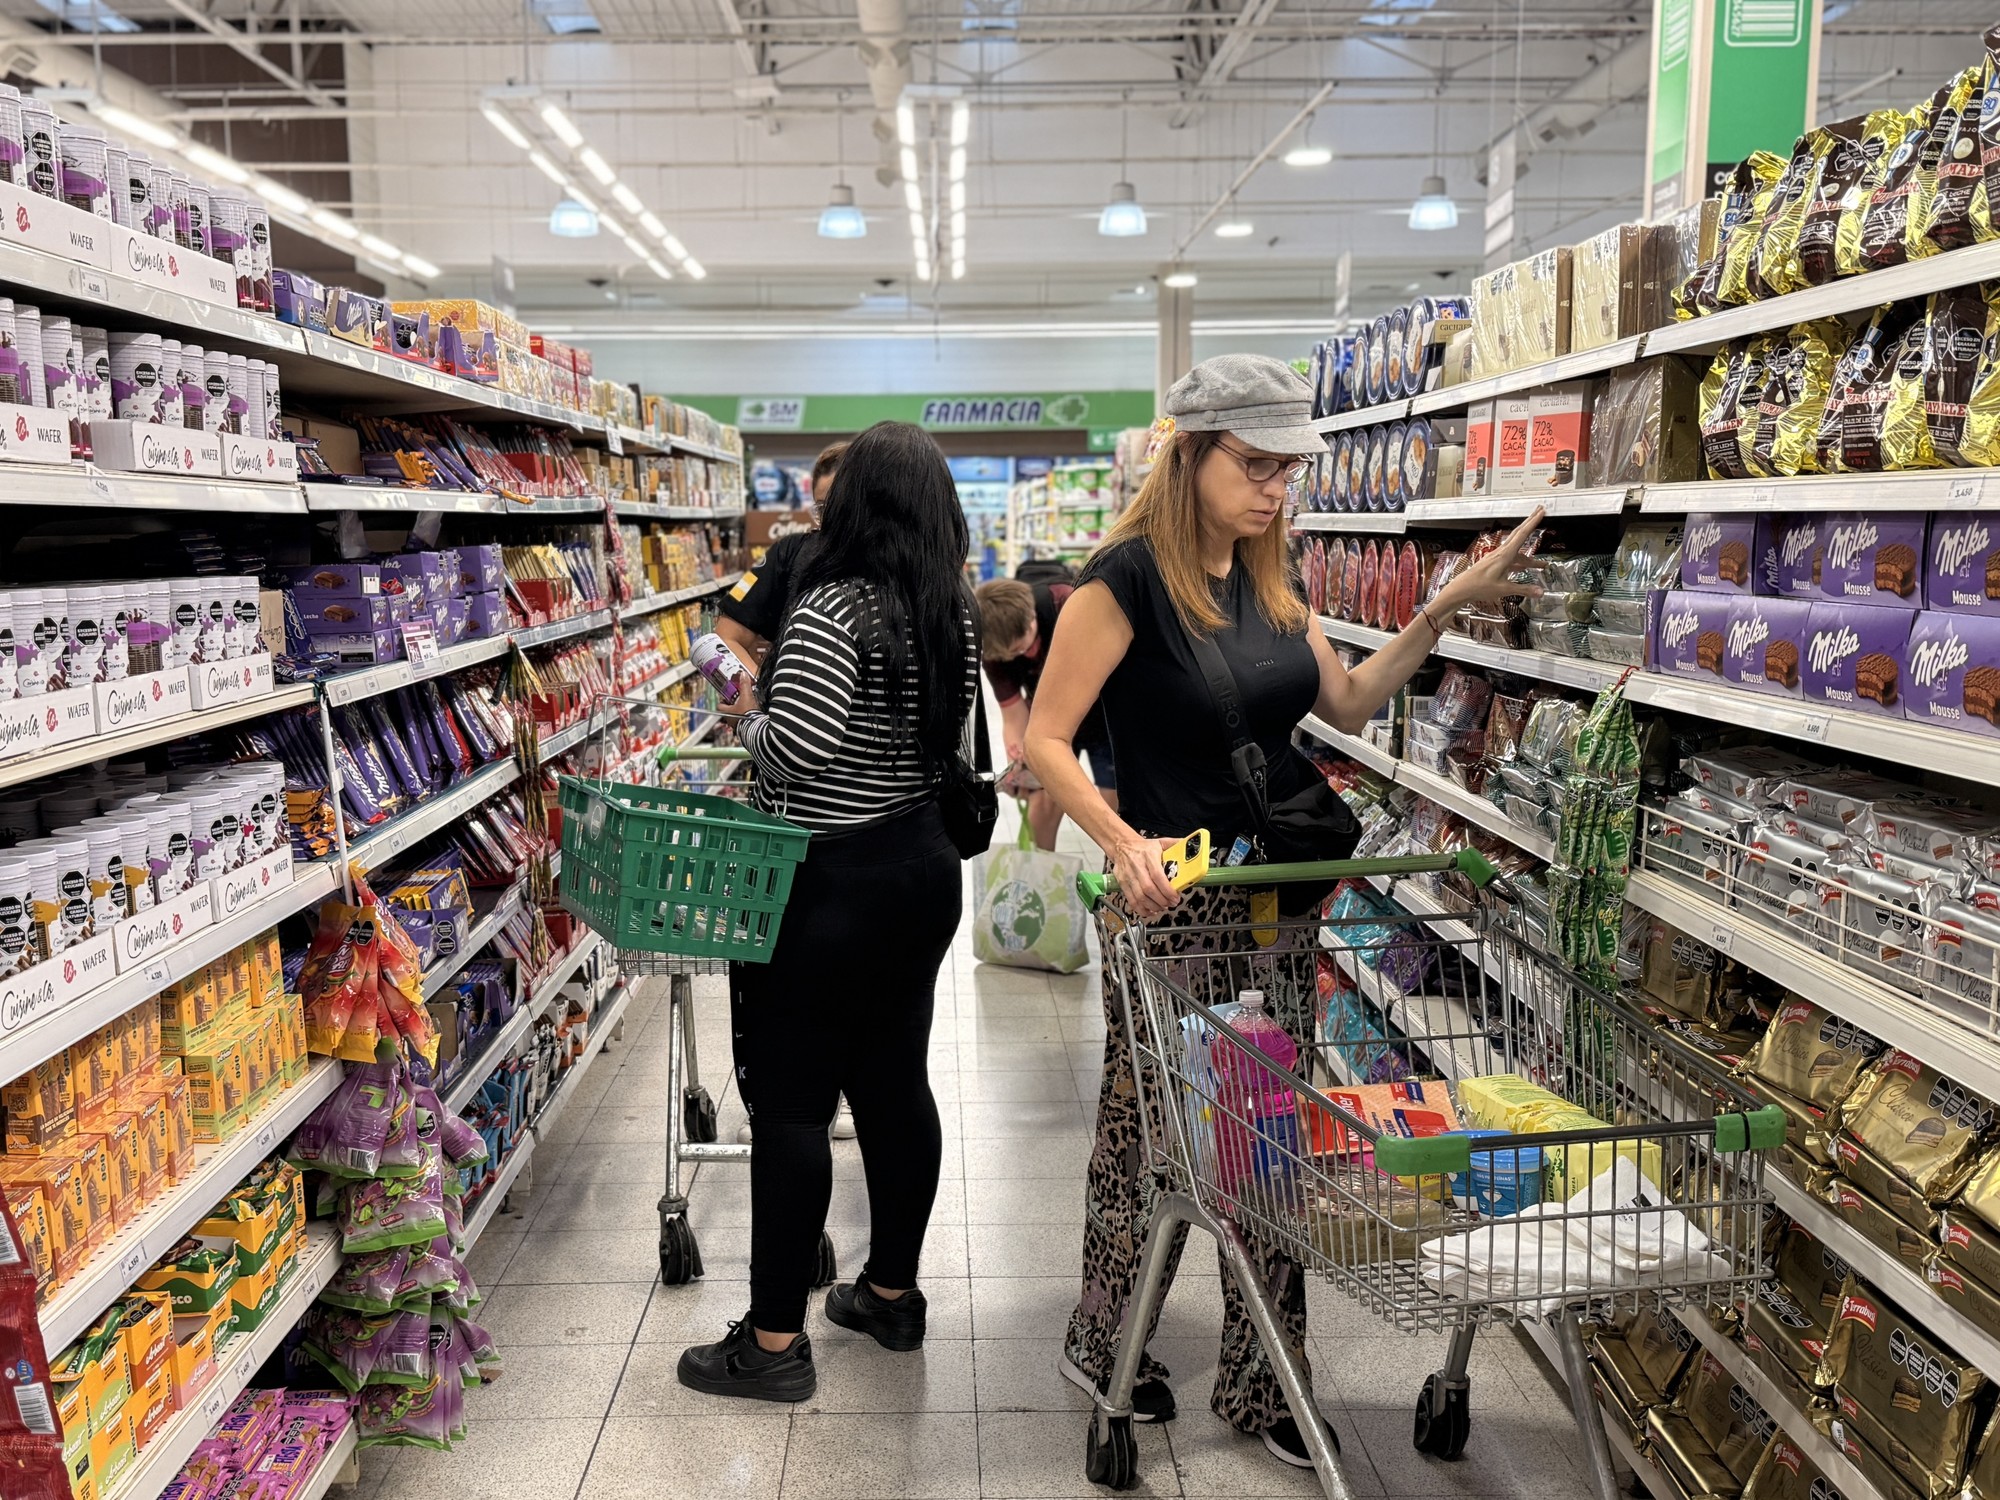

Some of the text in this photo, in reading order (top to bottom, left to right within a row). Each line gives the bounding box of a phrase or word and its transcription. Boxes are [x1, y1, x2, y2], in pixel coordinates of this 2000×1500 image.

[70, 231, 94, 251] WAFER
[209, 278, 226, 293] WAFER
[924, 400, 1041, 425] FARMACIA
[37, 428, 62, 444] WAFER
[1504, 425, 1527, 440] 72%
[1535, 421, 1553, 436] 72%
[1533, 438, 1554, 447] CACAO
[200, 448, 219, 462] WAFER
[278, 456, 293, 469] WAFER
[1686, 521, 1722, 562] Milka
[1782, 521, 1816, 567] Milka
[1828, 518, 1878, 569] Milka
[1935, 520, 1990, 576] Milka
[1767, 547, 1778, 588] Milka
[1698, 573, 1716, 584] Mousse
[1792, 578, 1810, 590] Mousse
[1845, 582, 1871, 595] Mousse
[1953, 591, 1981, 605] Mousse
[1663, 608, 1699, 648] Milka
[1728, 615, 1769, 658] Milka
[1808, 625, 1860, 673] Milka
[1676, 659, 1696, 672] Mousse
[1911, 634, 1968, 686] Milka
[256, 665, 270, 677] WAFER
[1741, 670, 1762, 684] Mousse
[168, 680, 187, 695] WAFER
[1826, 686, 1852, 701] Mousse
[67, 703, 90, 720] WAFER
[1930, 701, 1960, 719] Mousse
[273, 858, 288, 874] WAFER
[190, 894, 209, 913] WAFER
[82, 949, 107, 972] WAFER
